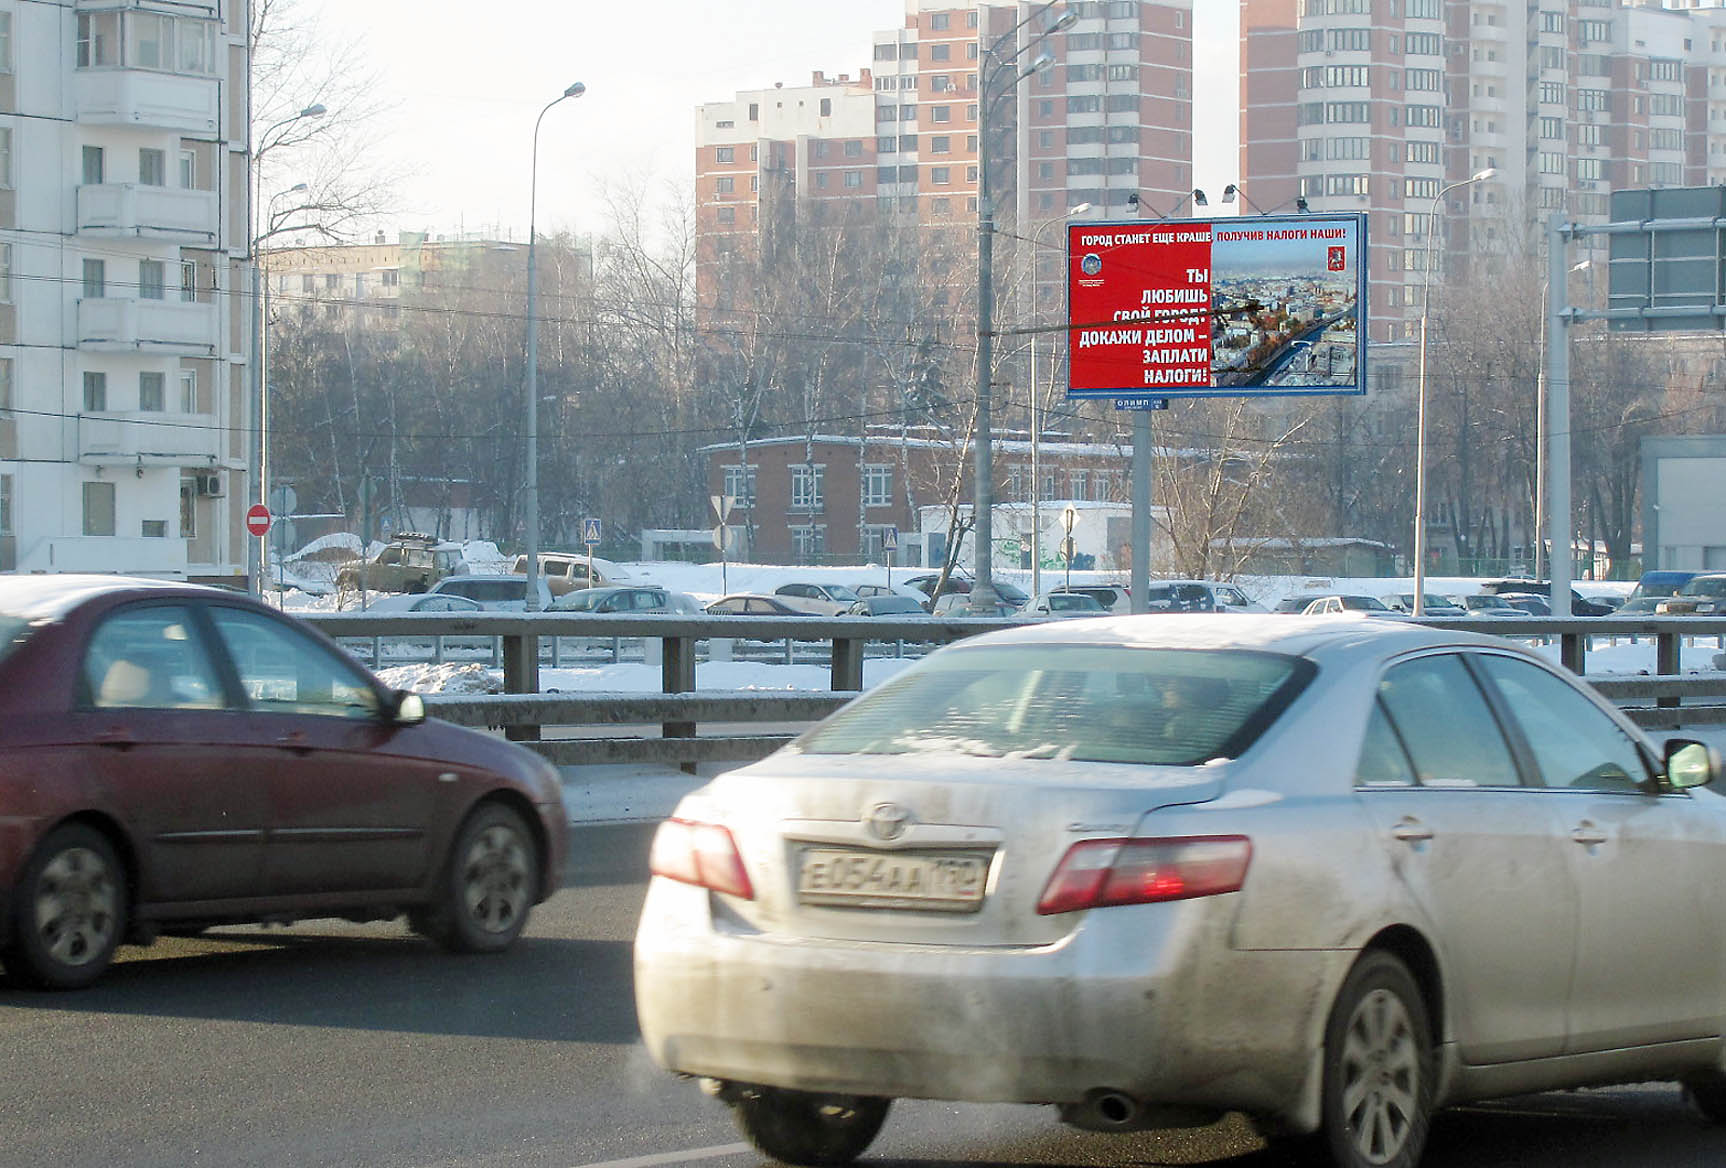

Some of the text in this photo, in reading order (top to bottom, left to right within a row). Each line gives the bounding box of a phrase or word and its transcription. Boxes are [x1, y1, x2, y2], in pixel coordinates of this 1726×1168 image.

[1081, 235, 1113, 247] ГОРОД
[1114, 234, 1151, 245] СТАНЕТ
[1152, 233, 1175, 244] ЕЩЕ
[1217, 231, 1264, 241] ПОЛУЧИВ
[1266, 230, 1307, 240] НАЛОГИ
[1310, 228, 1346, 239] НАШИ!
[1186, 269, 1208, 283] ТЫ
[1140, 288, 1208, 304] ЛЮБИШЬ
[1113, 306, 1151, 324] СВОЙ
[1079, 330, 1142, 348] ДОКАЖИ
[1145, 328, 1195, 345] ДЕЛОМ
[1142, 348, 1208, 363] ЗАПЛАТИ
[1144, 368, 1208, 384] НАЛОГИ!
